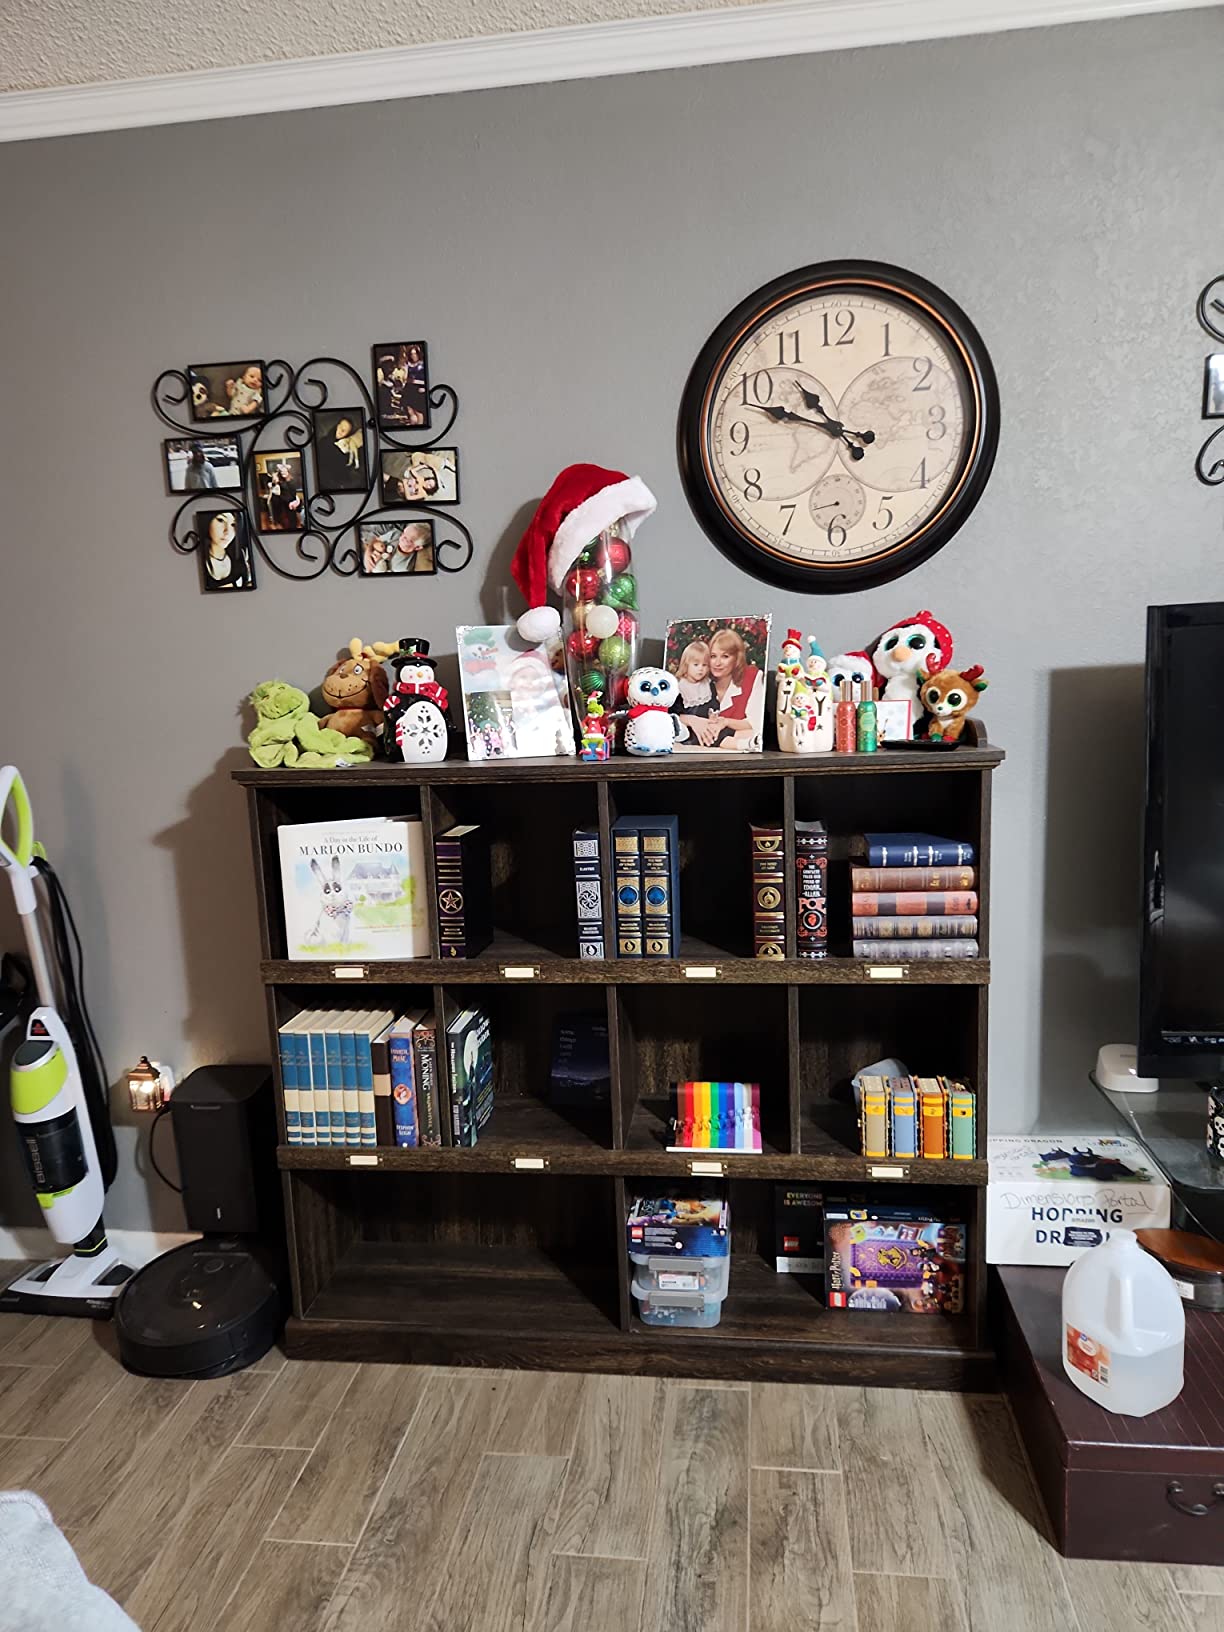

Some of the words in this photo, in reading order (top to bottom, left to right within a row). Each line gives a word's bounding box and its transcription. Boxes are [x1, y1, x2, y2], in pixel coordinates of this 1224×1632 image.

[820, 309, 856, 347] 12
[879, 322, 892, 357] 1
[776, 329, 803, 366] 11
[738, 368, 774, 406] 10
[912, 356, 934, 392] 2
[729, 420, 750, 457] 9
[926, 405, 947, 441] 3
[743, 467, 764, 502] 8
[909, 456, 931, 490] 4
[779, 504, 797, 536] 7
[826, 513, 848, 548] 6
[872, 495, 895, 531] 5
[299, 843, 355, 856] MARLON
[357, 842, 403, 854] BUNDO
[420, 1053, 431, 1091] MONING
[1097, 1188, 1155, 1212] Portal
